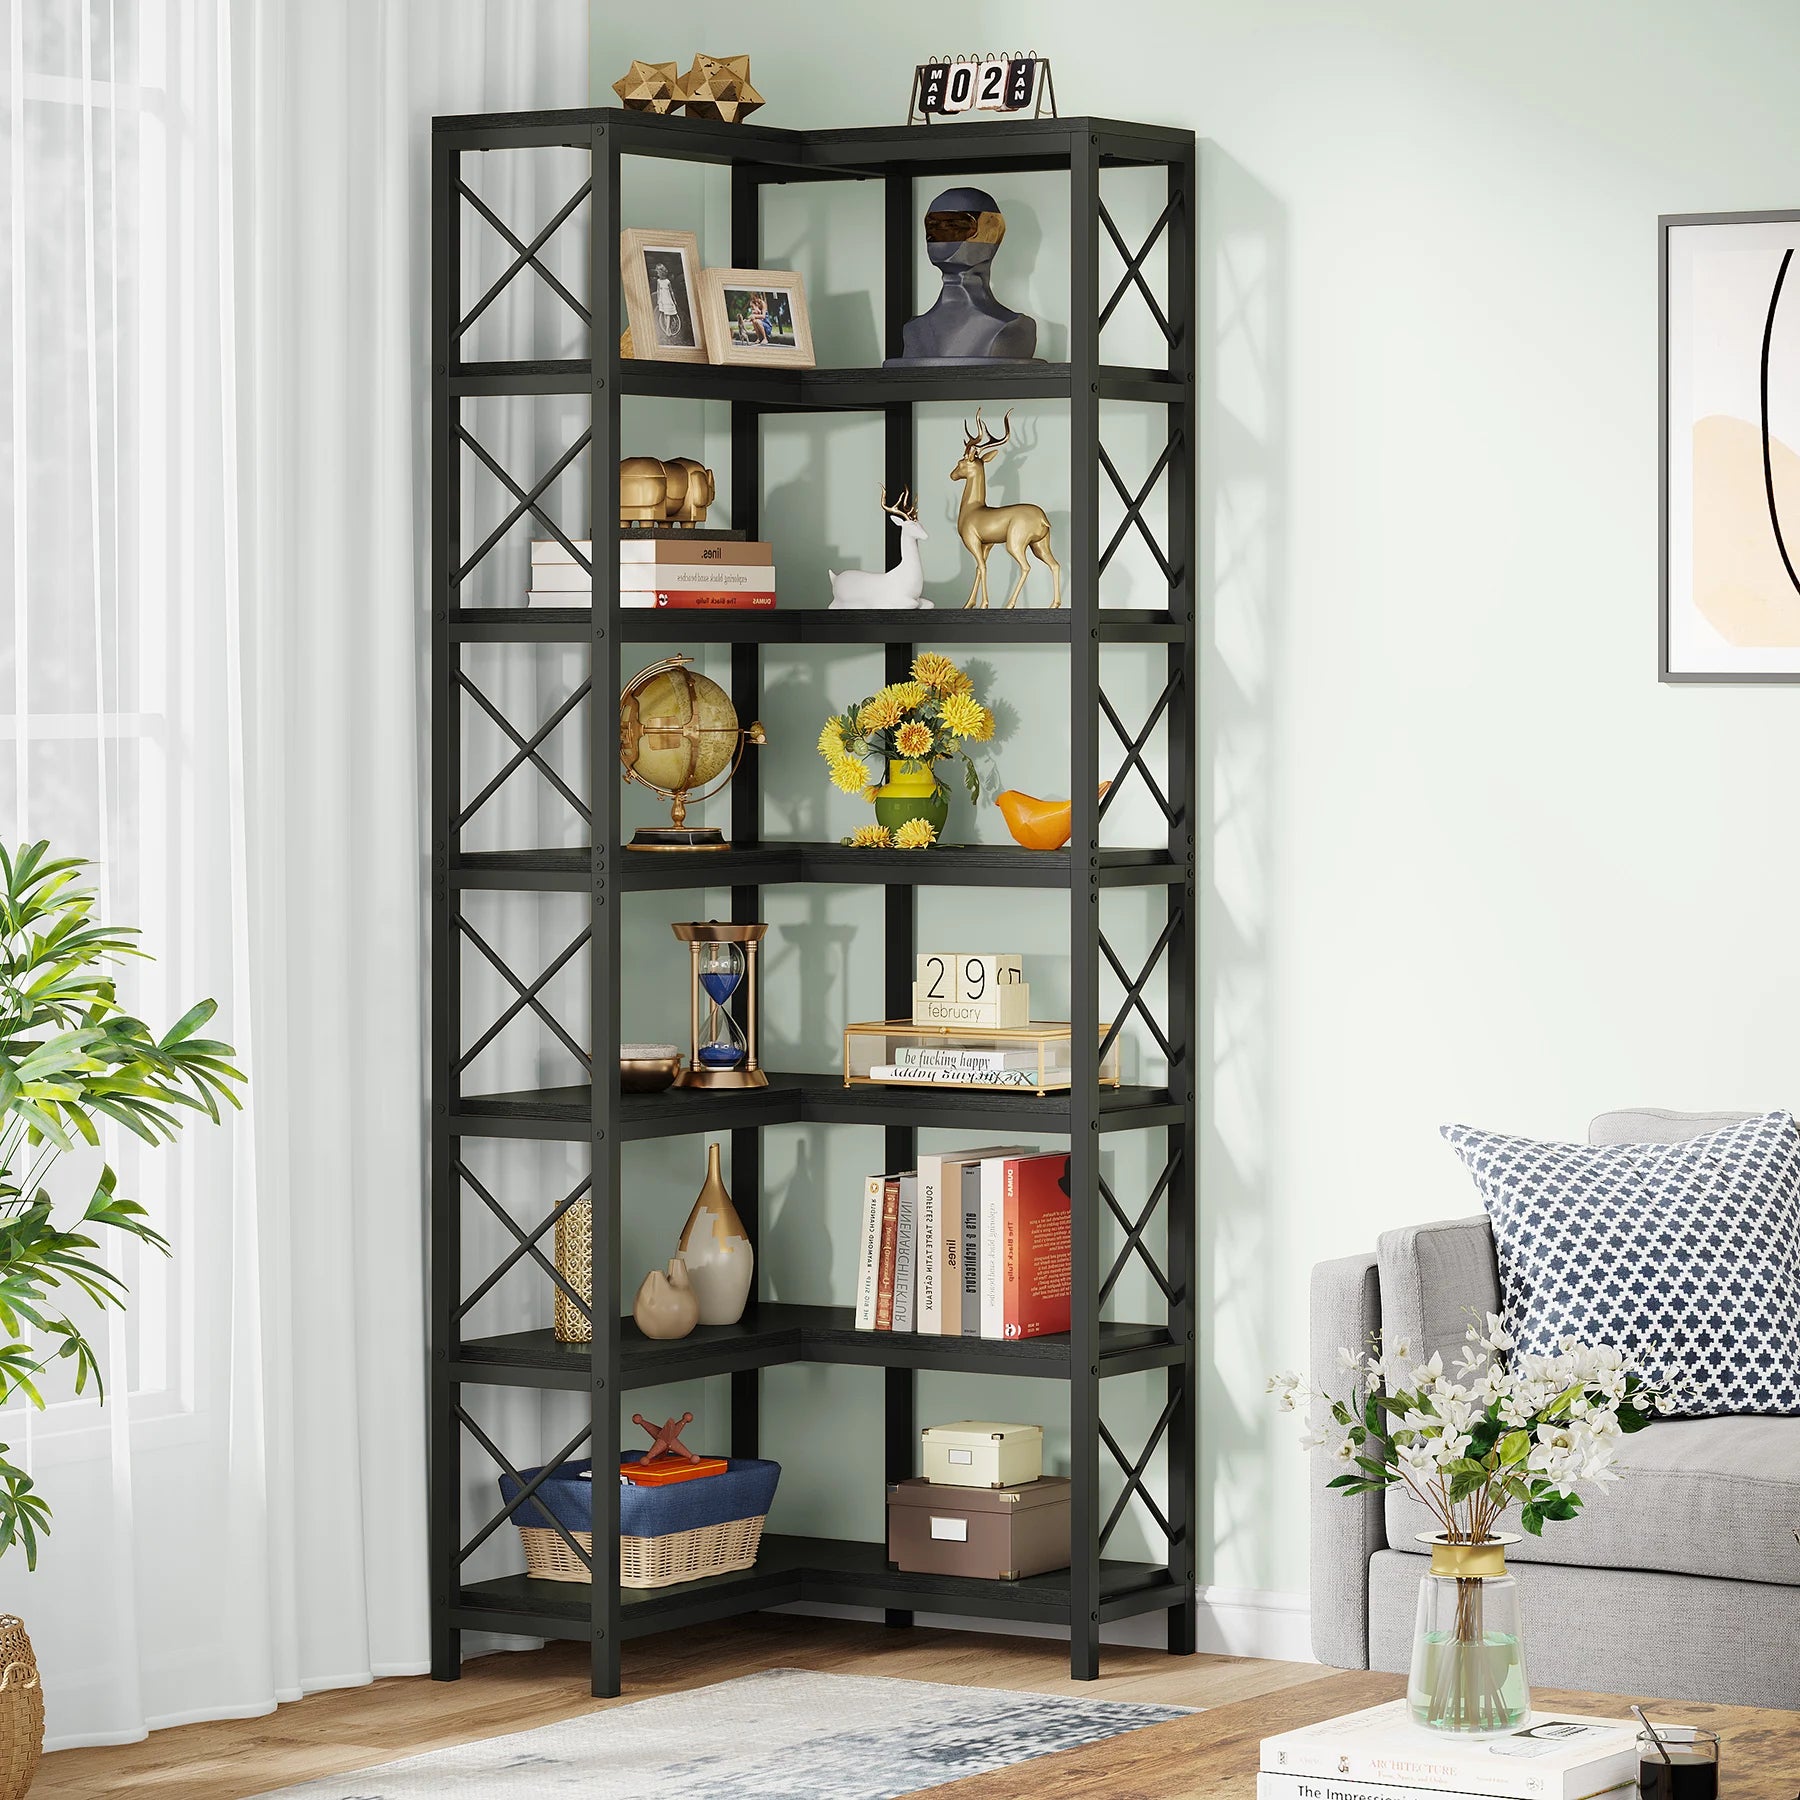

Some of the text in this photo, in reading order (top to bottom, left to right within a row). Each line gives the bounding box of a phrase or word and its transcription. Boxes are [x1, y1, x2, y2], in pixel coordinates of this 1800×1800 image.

[927, 69, 943, 105] MAR
[1014, 64, 1026, 100] JAN
[928, 1002, 981, 1023] february
[904, 1049, 991, 1072] be fucking happy
[890, 1067, 937, 1083] happy
[1369, 1759, 1457, 1777] ARCHITECTURE
[1298, 1785, 1321, 1798] The
